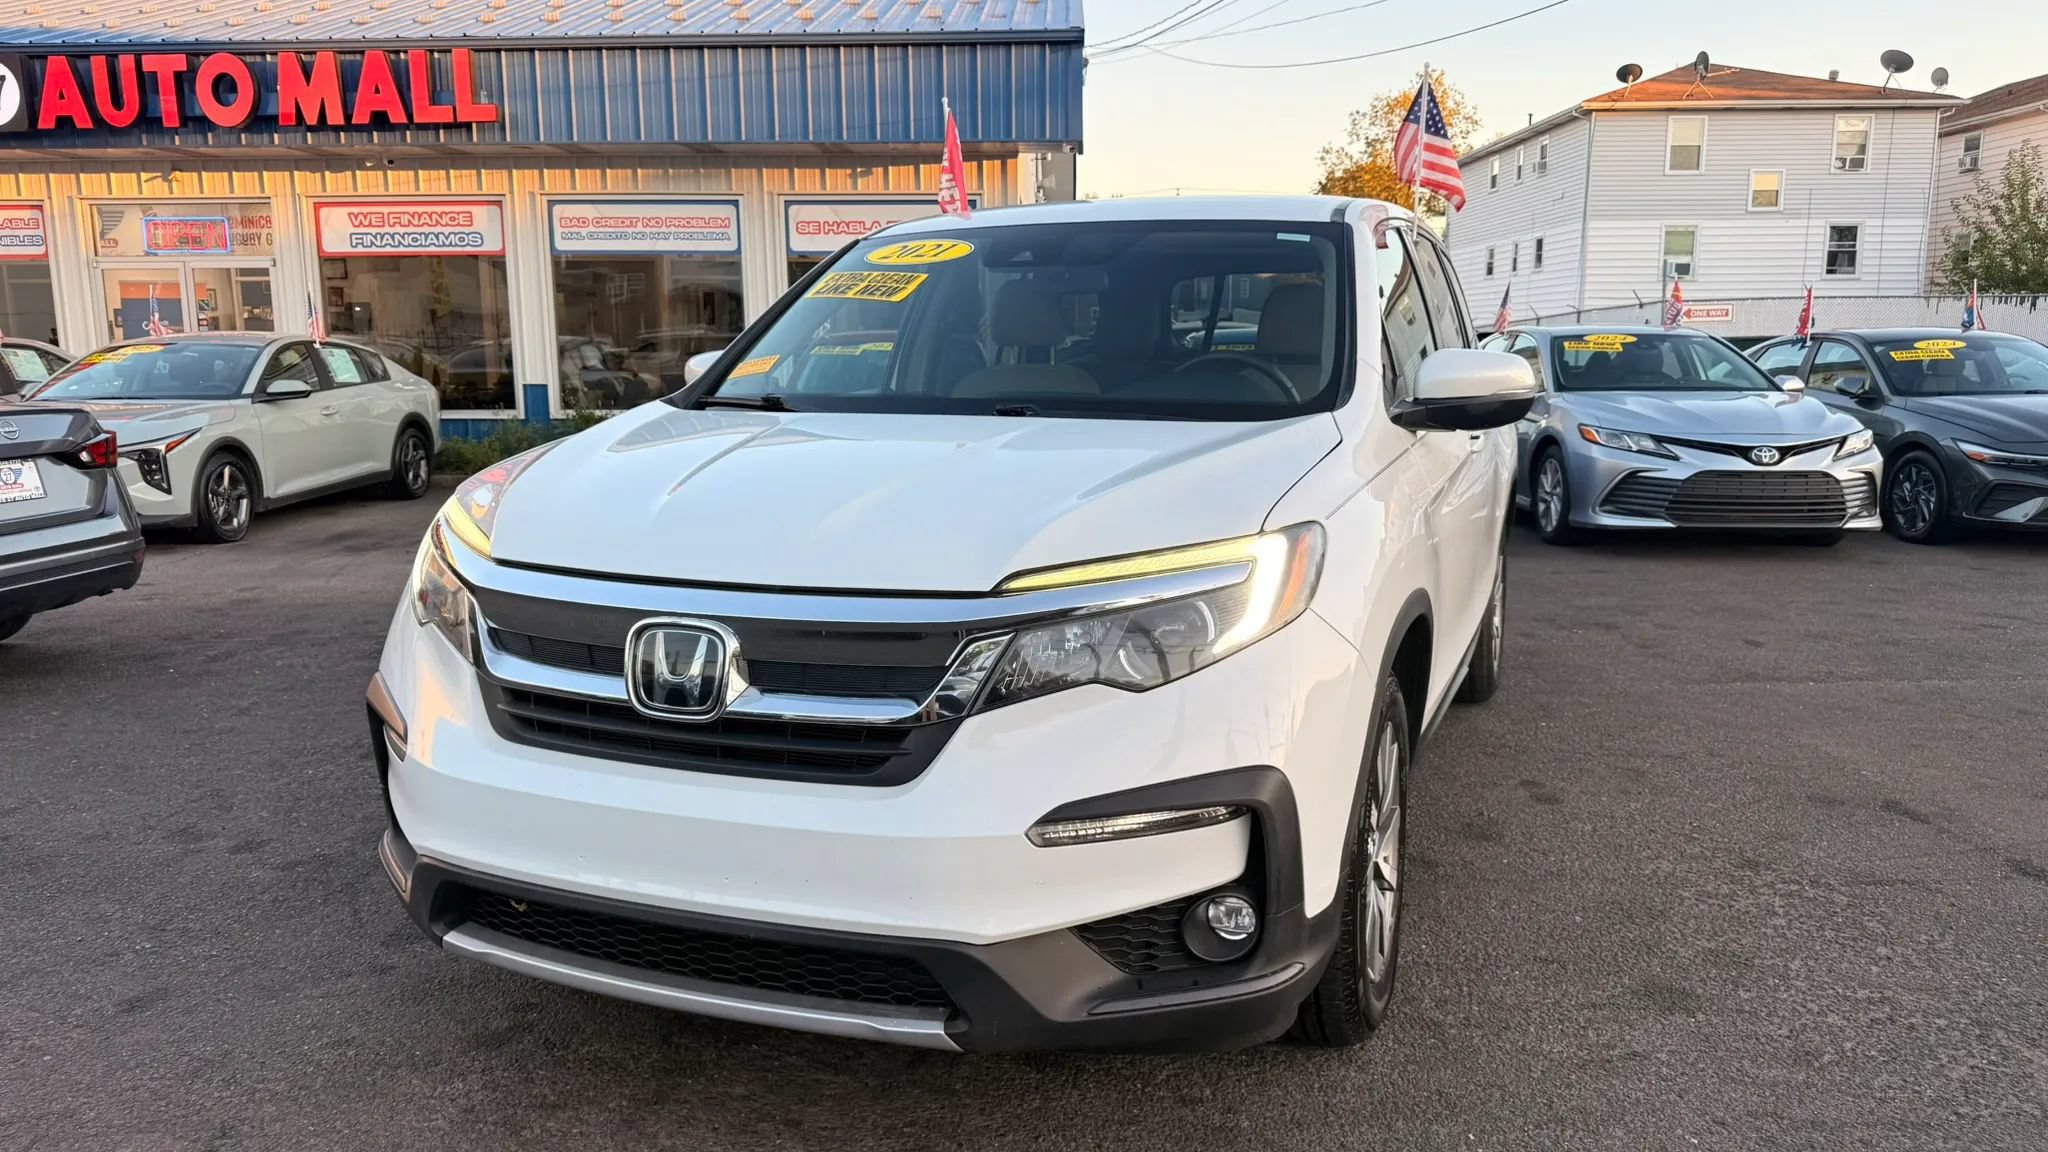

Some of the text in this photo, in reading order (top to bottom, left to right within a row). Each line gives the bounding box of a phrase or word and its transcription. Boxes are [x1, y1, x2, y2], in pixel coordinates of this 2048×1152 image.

[36, 52, 255, 129] AUTO
[278, 48, 498, 126] MALL
[0, 218, 40, 230] ABLE
[348, 211, 473, 228] WE FINANCE
[560, 217, 731, 228] BAD CREDIT NO PROBLEM
[796, 221, 822, 235] SE
[146, 221, 226, 250] OPEN
[350, 231, 484, 248] FINANCIAMOS
[561, 231, 731, 241] MAL CREDITO NO HAY PROBLEMA
[877, 243, 959, 260] 2021
[825, 273, 919, 286] EXTRA CLEAN
[812, 283, 907, 297] LIKE NEW
